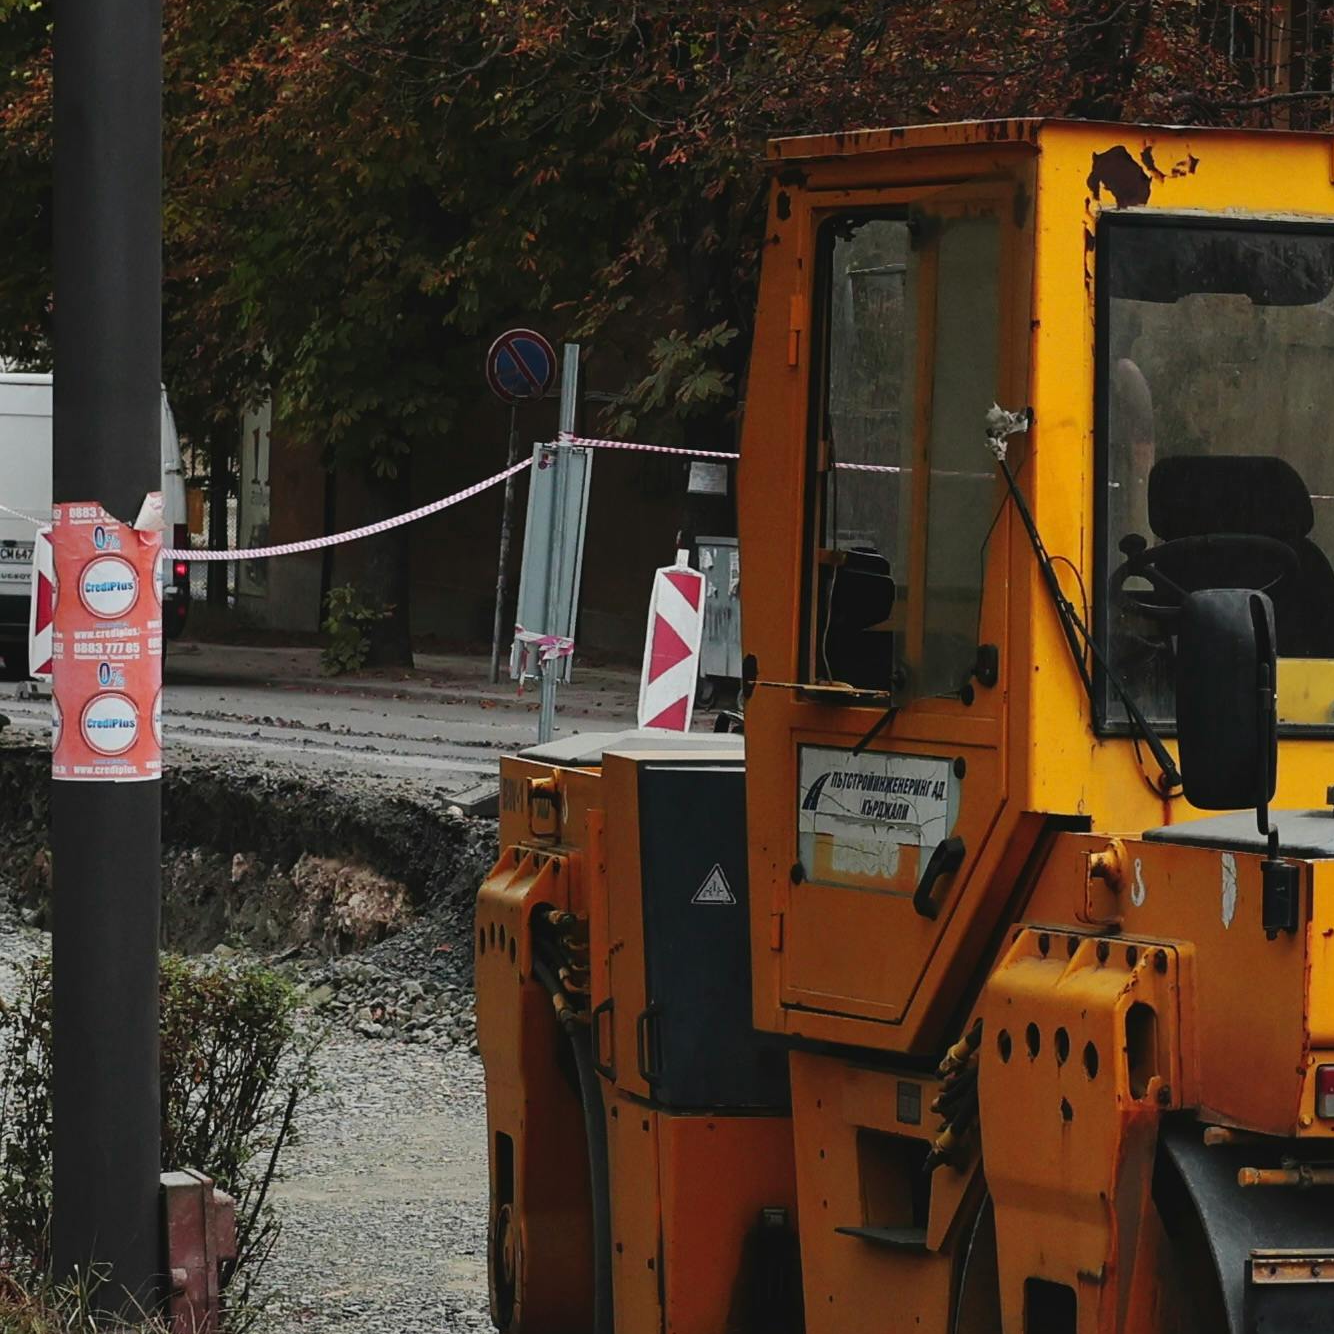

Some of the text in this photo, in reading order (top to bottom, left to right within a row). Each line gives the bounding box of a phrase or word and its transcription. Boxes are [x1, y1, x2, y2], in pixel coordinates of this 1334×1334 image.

[85, 581, 134, 593] CrediPlus
[105, 643, 123, 654] 777
[88, 718, 135, 729] CrediPlus
[830, 771, 946, 801] ПЪТСТРОЙИНЖЕНЕРИНГ АД
[861, 798, 910, 821] КЪРДЖАЛИ
